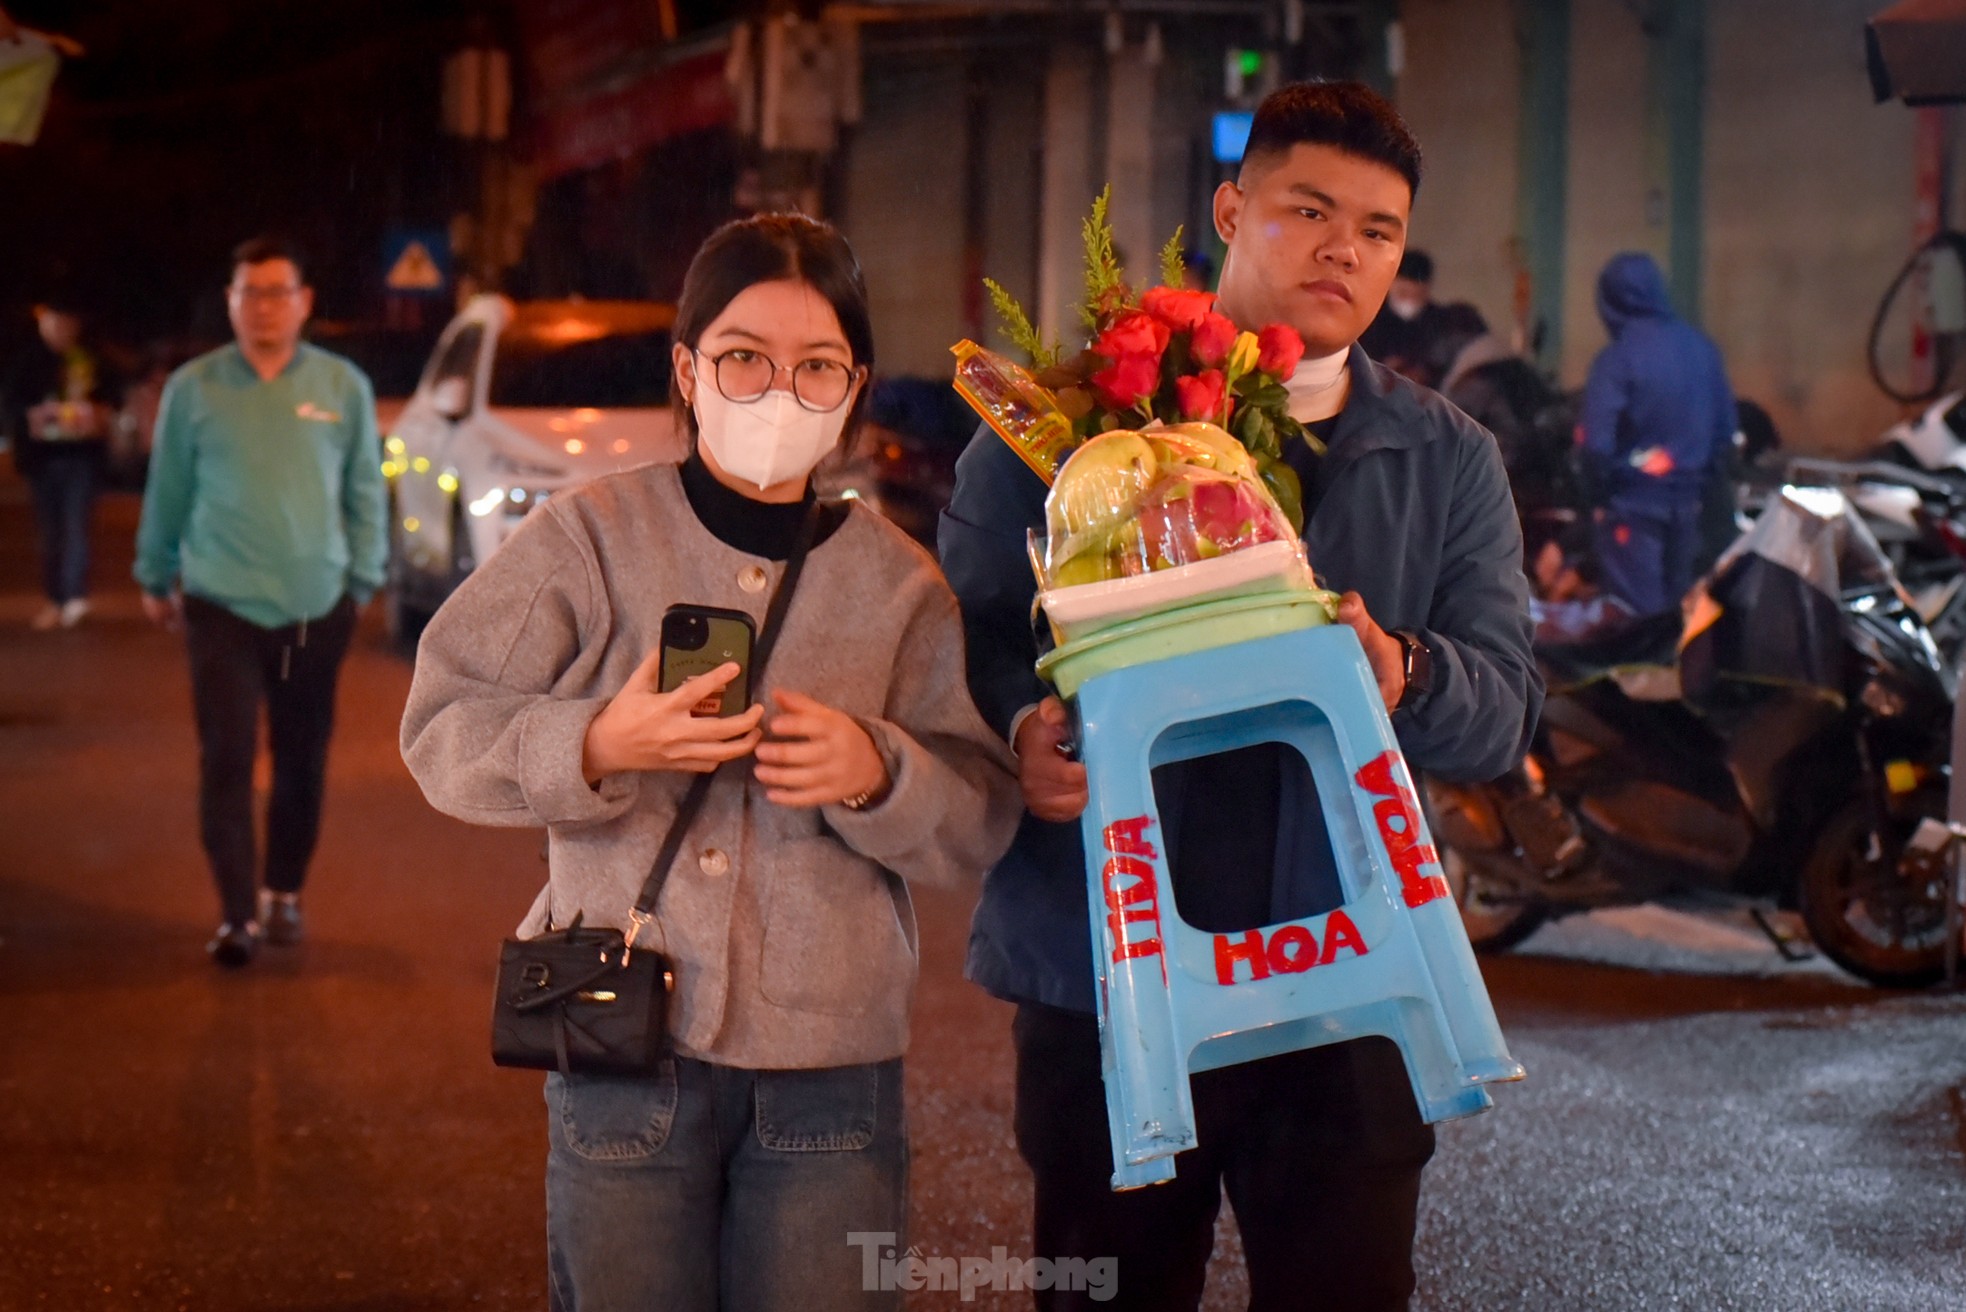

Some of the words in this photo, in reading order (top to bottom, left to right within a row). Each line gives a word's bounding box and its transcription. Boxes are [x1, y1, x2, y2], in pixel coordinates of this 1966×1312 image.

[1102, 814, 1166, 984] HOA
[1355, 749, 1452, 908] HOA
[1213, 909, 1369, 986] HOA
